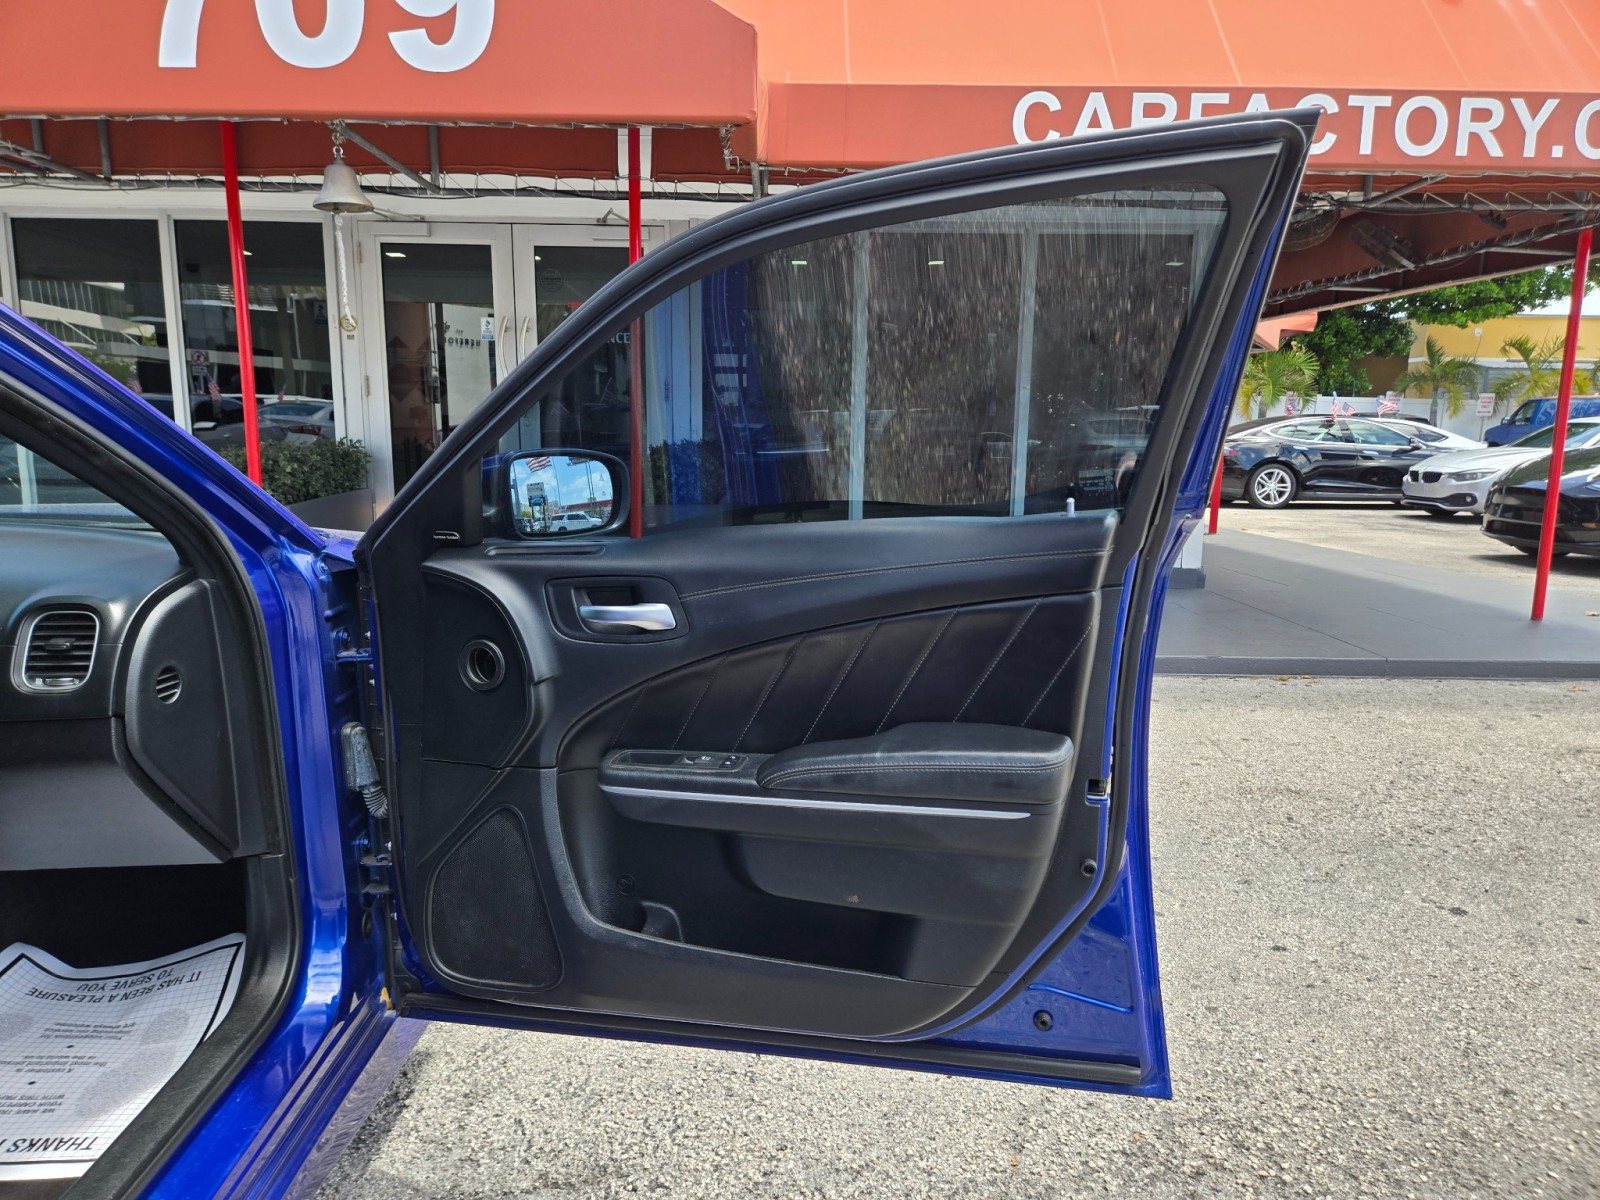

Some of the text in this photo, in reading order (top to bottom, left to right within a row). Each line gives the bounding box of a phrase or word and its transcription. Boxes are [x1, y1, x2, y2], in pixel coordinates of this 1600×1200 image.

[25, 970, 202, 1003] IT HAS BEEN A PLEASURE
[76, 968, 174, 992] TO SERVE YOU
[6, 1136, 99, 1154] THANKS
